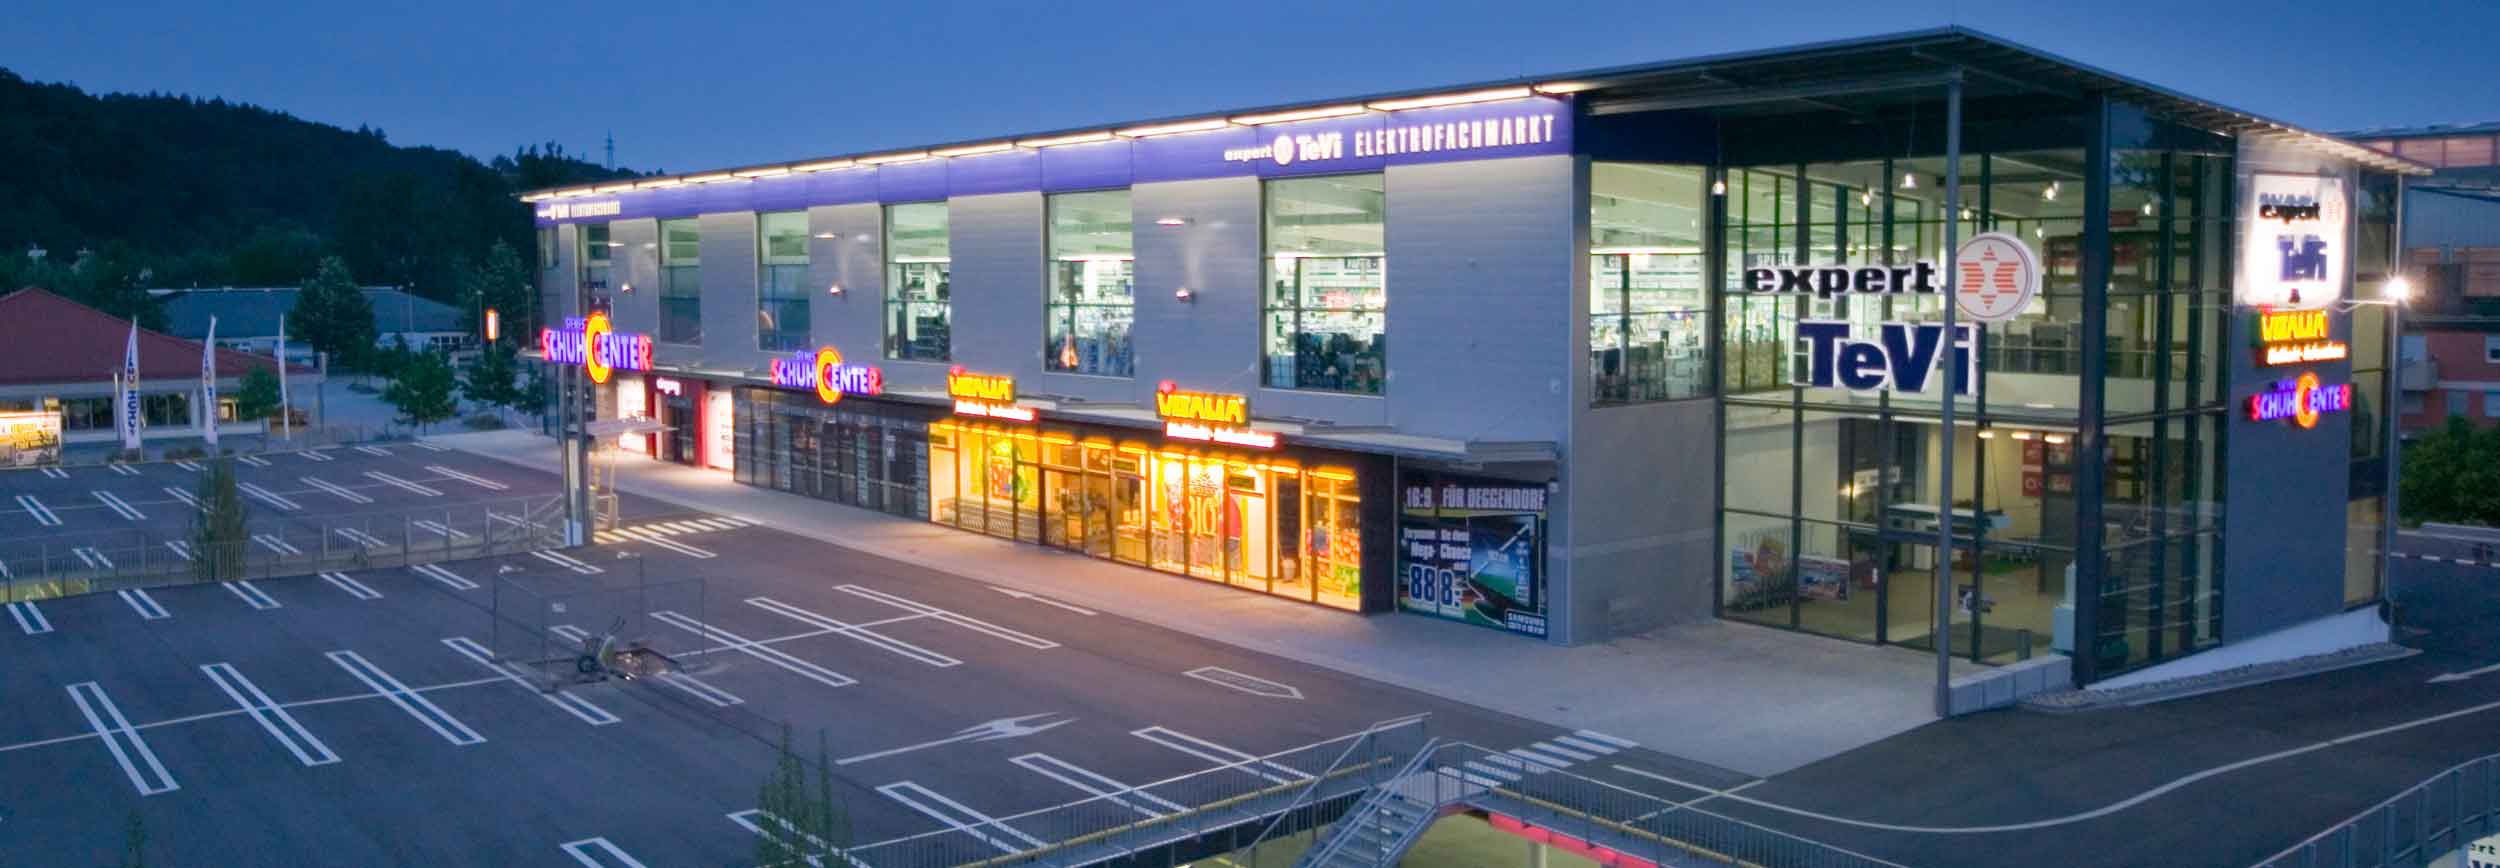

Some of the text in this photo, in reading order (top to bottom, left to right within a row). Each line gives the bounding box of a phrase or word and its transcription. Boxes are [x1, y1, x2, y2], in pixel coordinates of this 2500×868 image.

[1296, 132, 1343, 160] TeVi
[1355, 114, 1554, 157] ELEKTROFACHMARKT
[1744, 261, 1936, 299] expert
[1798, 321, 1972, 396] TeVi
[1406, 486, 1433, 508] 16:9
[1443, 484, 1465, 508] FÜR
